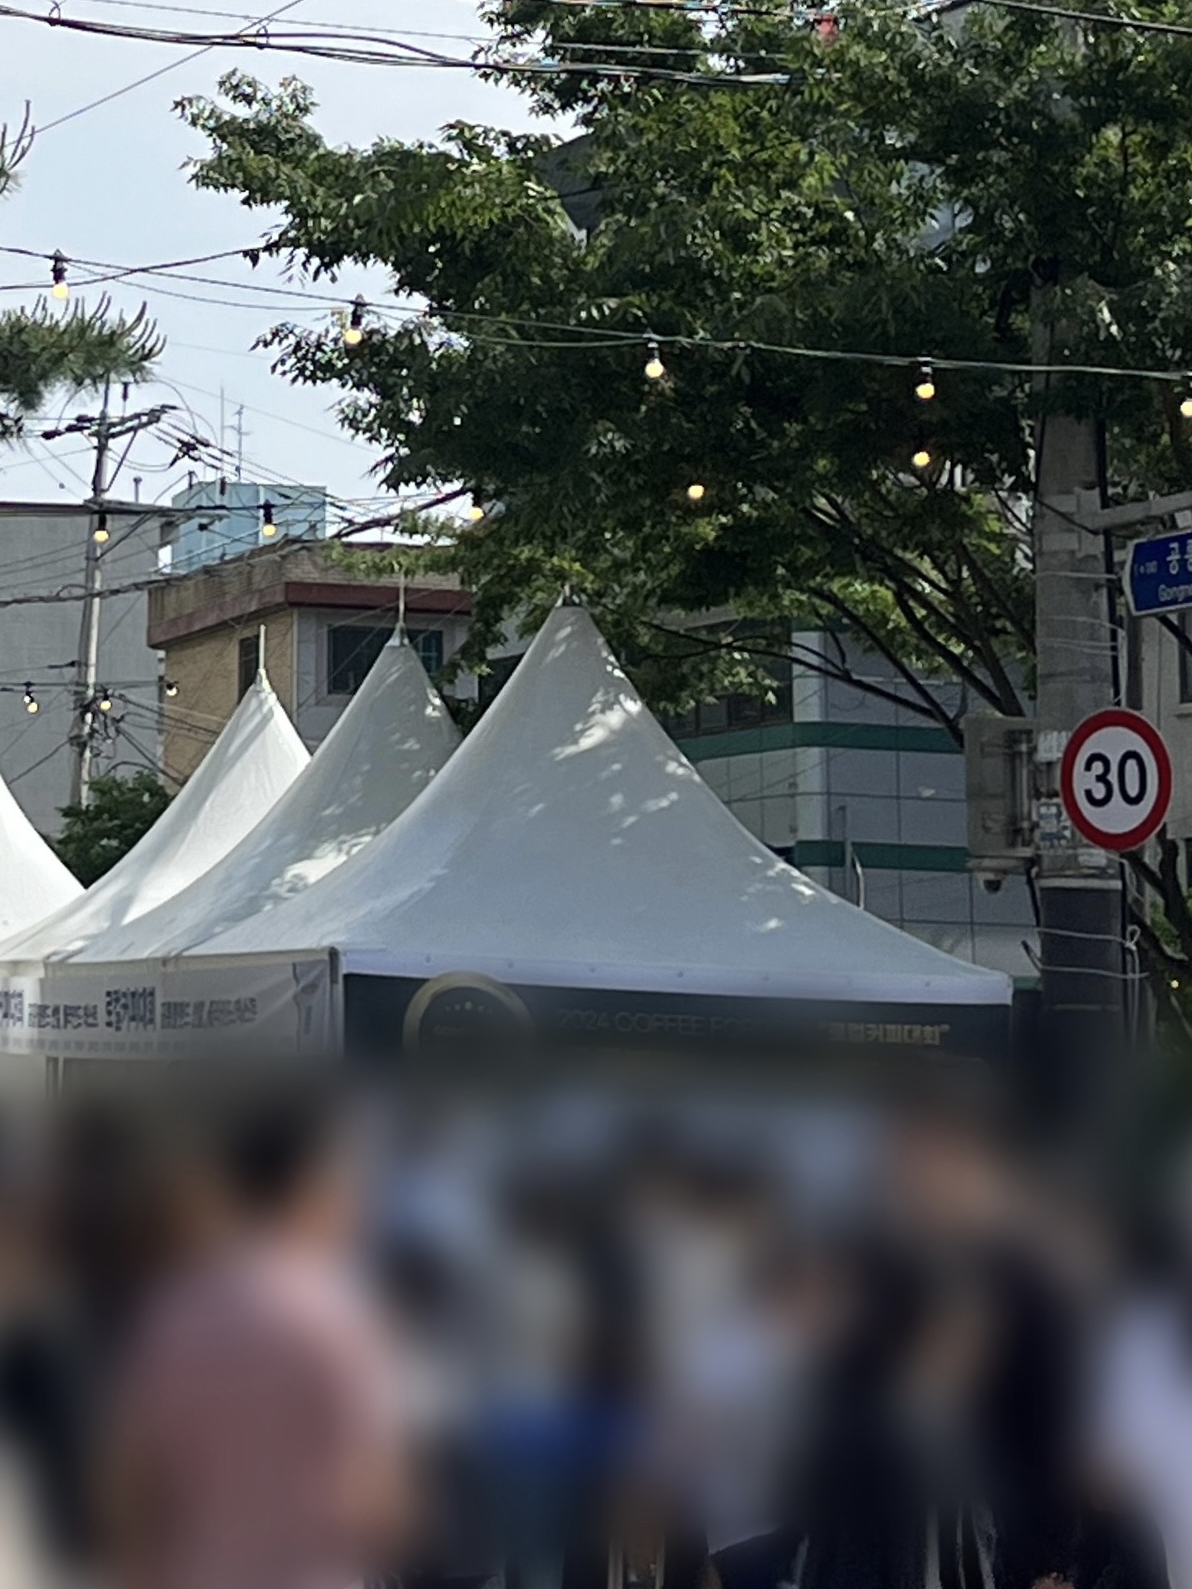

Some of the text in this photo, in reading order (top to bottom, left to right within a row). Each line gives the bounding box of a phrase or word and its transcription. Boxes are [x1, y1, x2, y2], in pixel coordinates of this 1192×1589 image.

[1083, 749, 1148, 809] 30
[556, 1008, 610, 1030] 2024
[614, 1011, 705, 1036] COFFEE
